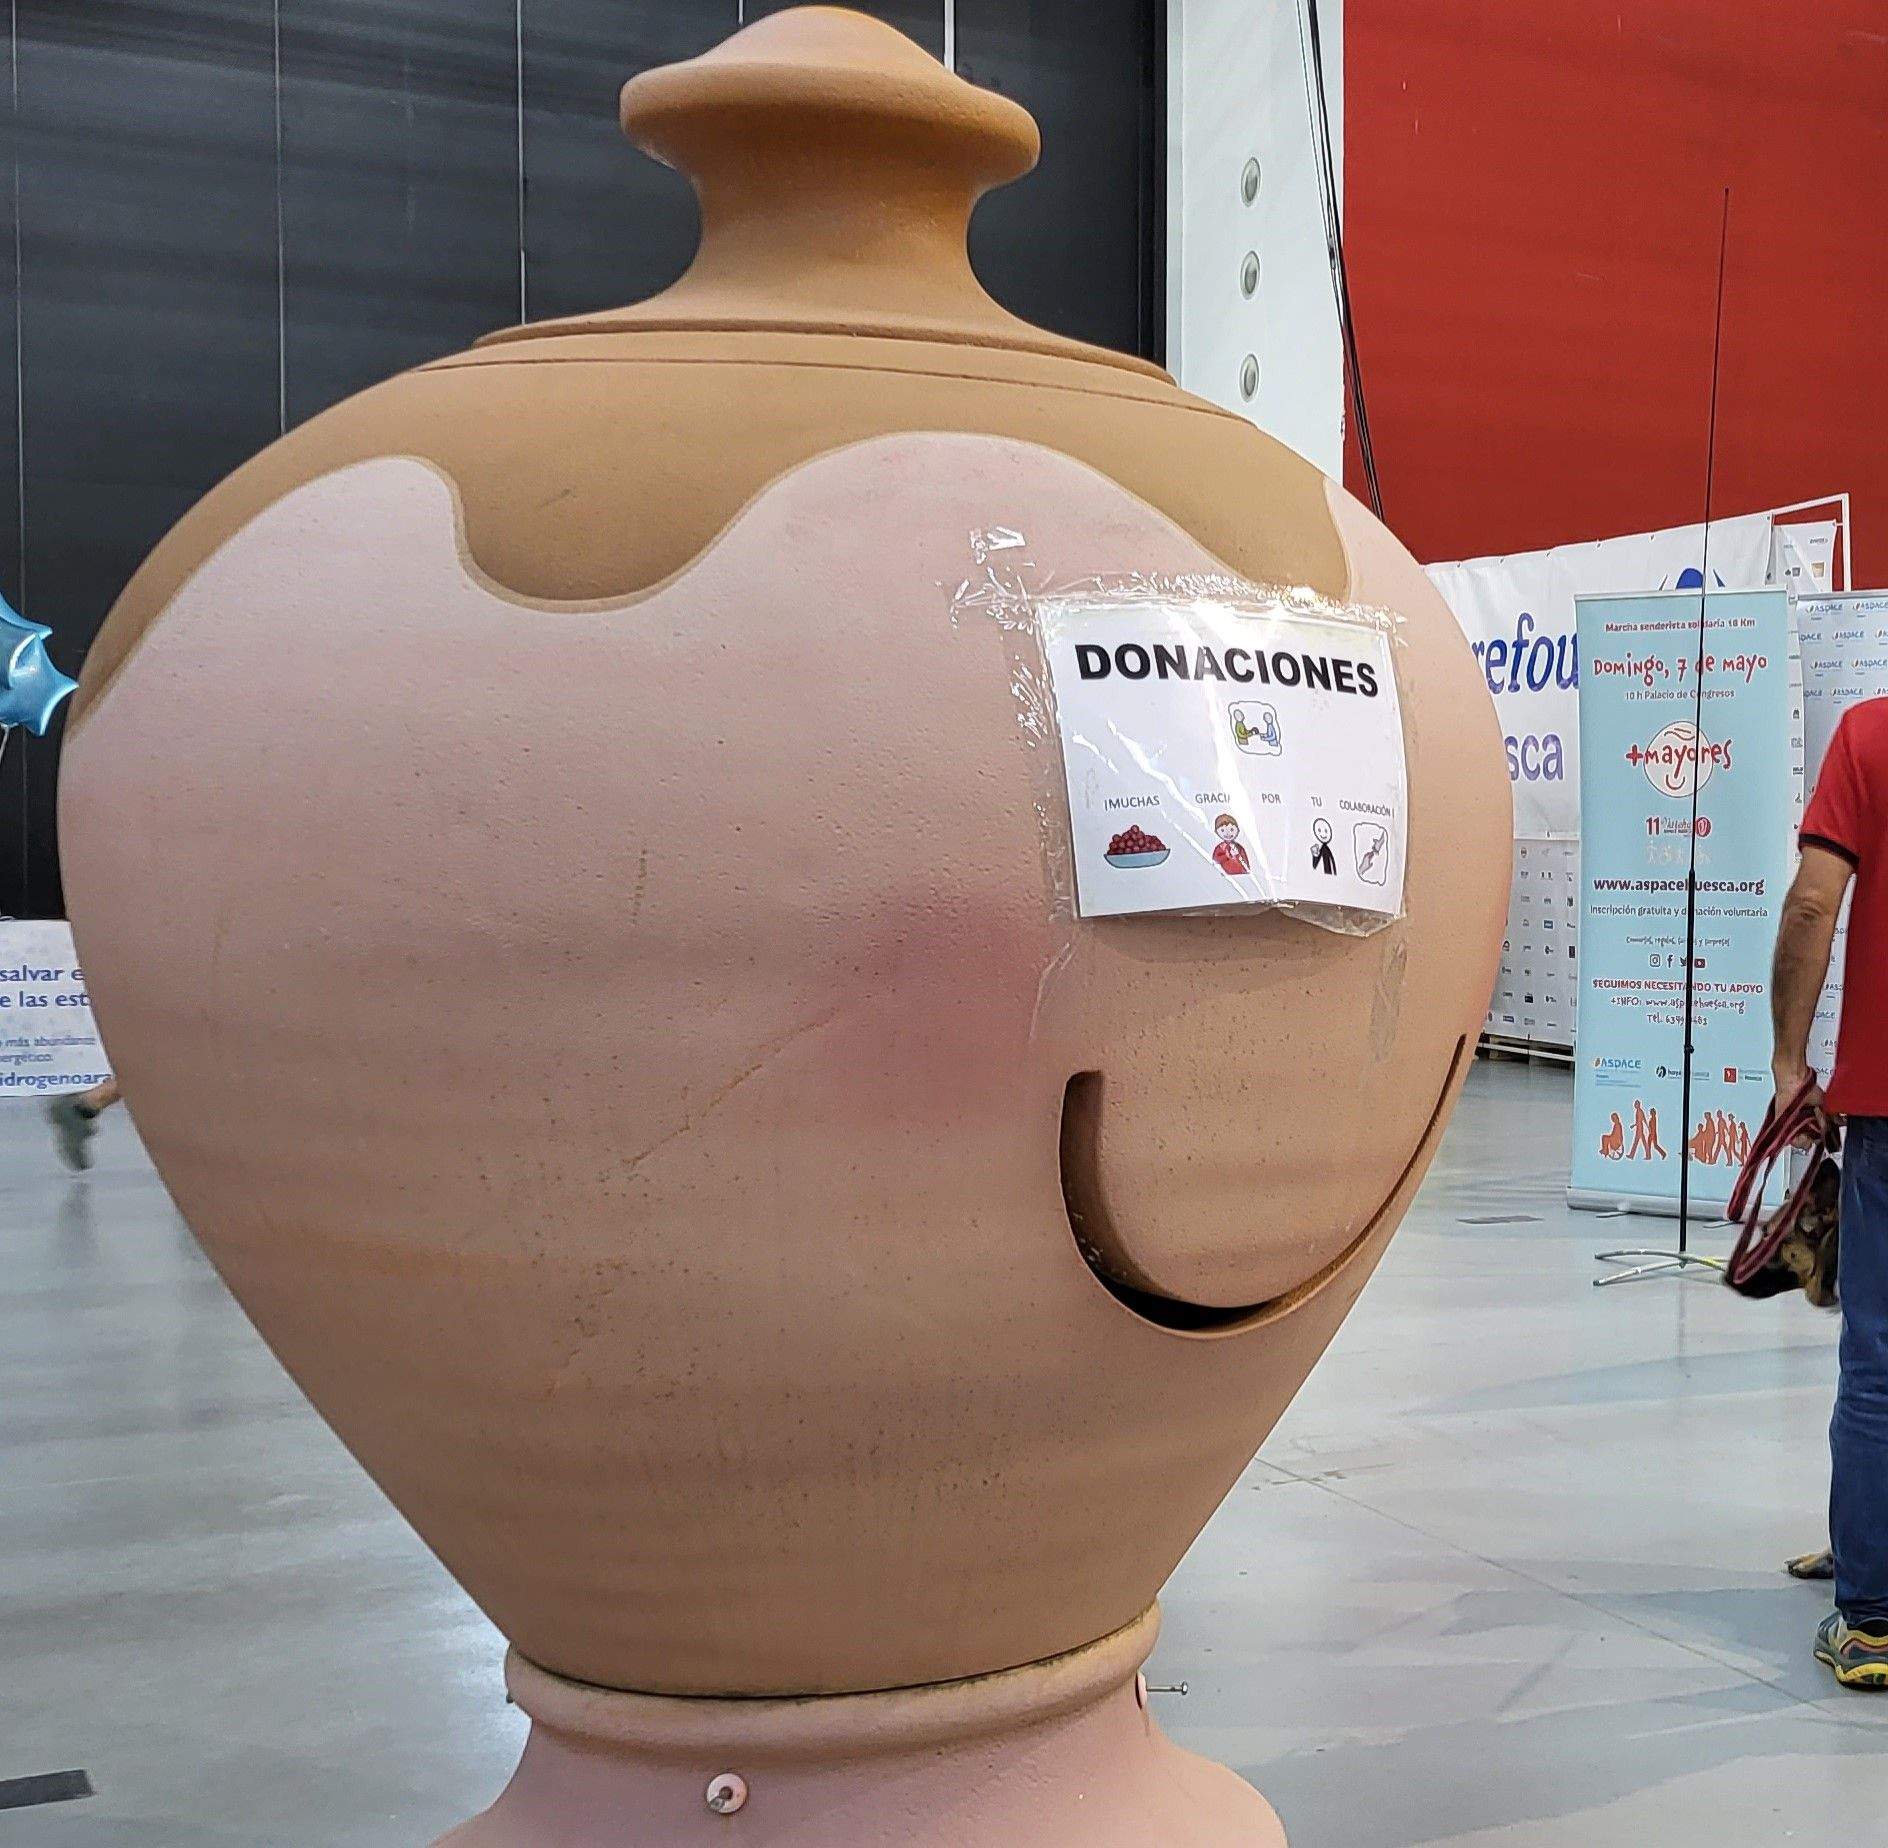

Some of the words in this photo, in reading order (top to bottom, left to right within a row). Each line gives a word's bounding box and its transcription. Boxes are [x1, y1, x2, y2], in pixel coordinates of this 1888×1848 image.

[1605, 622, 1638, 632] Marcha
[1640, 620, 1686, 632] senderista
[1740, 617, 1756, 628] Km
[1074, 643, 1379, 698] DONACIONES
[1593, 652, 1670, 687] Domingo,
[1677, 658, 1688, 682] 7
[1722, 654, 1768, 683] mayo
[1644, 690, 1674, 700] Palacio
[1677, 690, 1687, 699] de
[1689, 689, 1735, 700] Cngresos
[1504, 733, 1564, 782] sca
[1261, 793, 1281, 804] POR
[1311, 796, 1322, 807] TU
[1646, 817, 1660, 835] 11
[1590, 904, 1636, 916] Inscripción
[1637, 906, 1672, 917] gratuita
[1674, 907, 1680, 917] y
[1681, 906, 1721, 917] dnación
[1723, 907, 1768, 917] voluntaria
[0, 965, 64, 982] salvar
[1592, 978, 1642, 990] SEGUIMOS
[1715, 983, 1727, 993] TU
[1729, 983, 1763, 994] APOYO
[19, 991, 48, 1008] las
[1600, 1058, 1642, 1069] ASPACE
